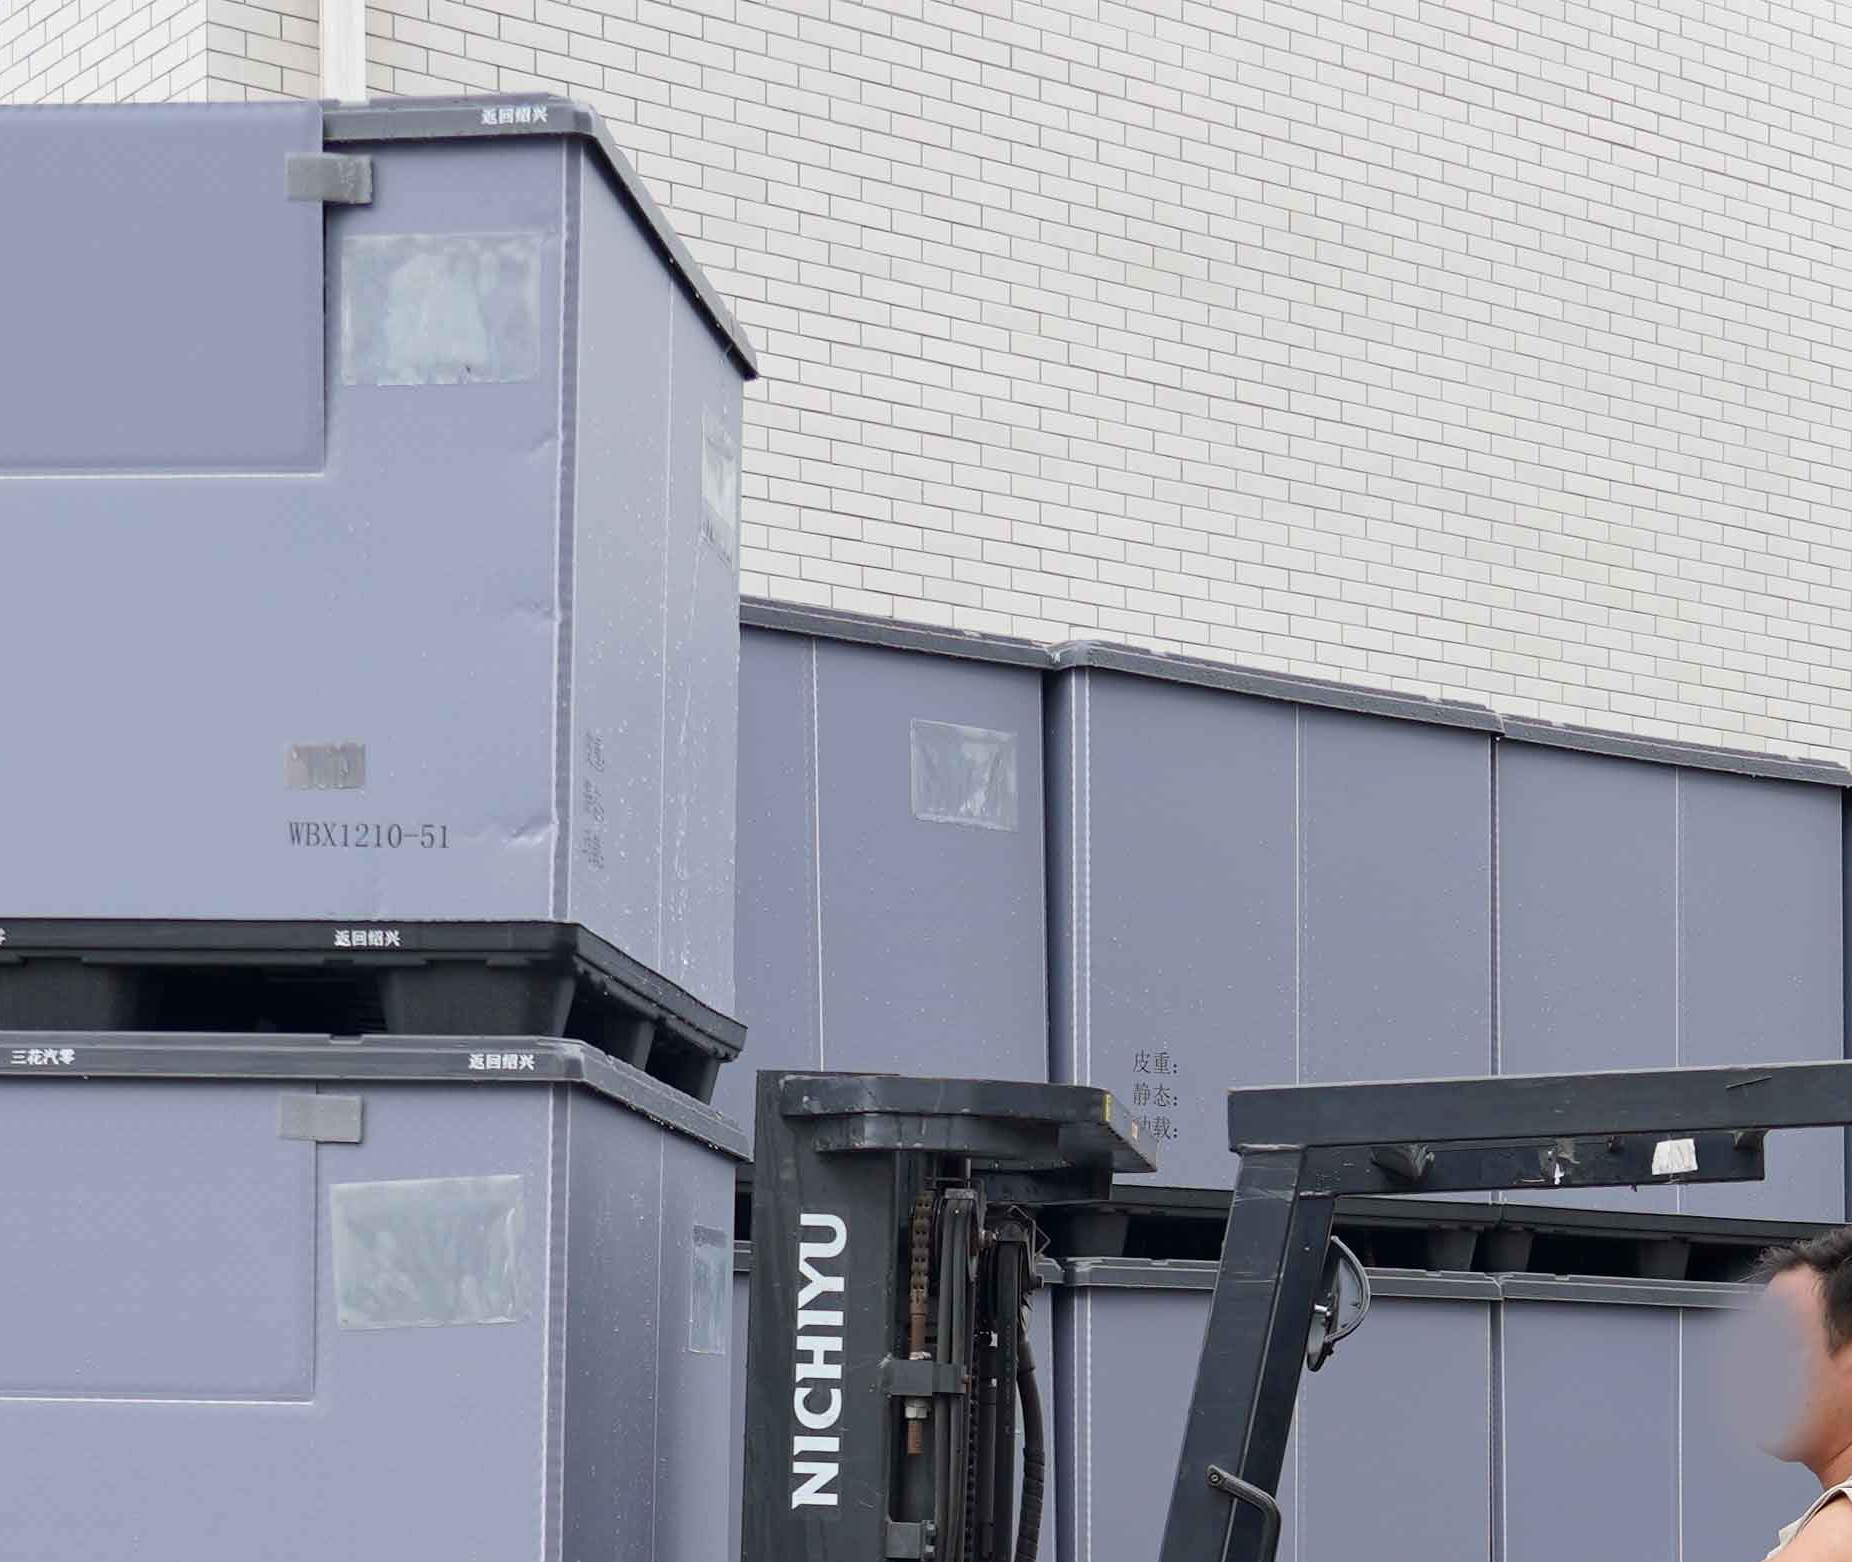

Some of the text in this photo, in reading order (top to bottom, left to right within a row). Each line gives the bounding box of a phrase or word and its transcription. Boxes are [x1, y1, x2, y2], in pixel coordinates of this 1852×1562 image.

[479, 107, 548, 126] 返回绍兴
[288, 821, 450, 850] WBX1210-51
[334, 929, 401, 948] 返回绍兴
[11, 1047, 75, 1065] 三花汽零
[468, 1053, 535, 1071] 返回绍兴
[791, 1213, 848, 1510] NICHIYU
